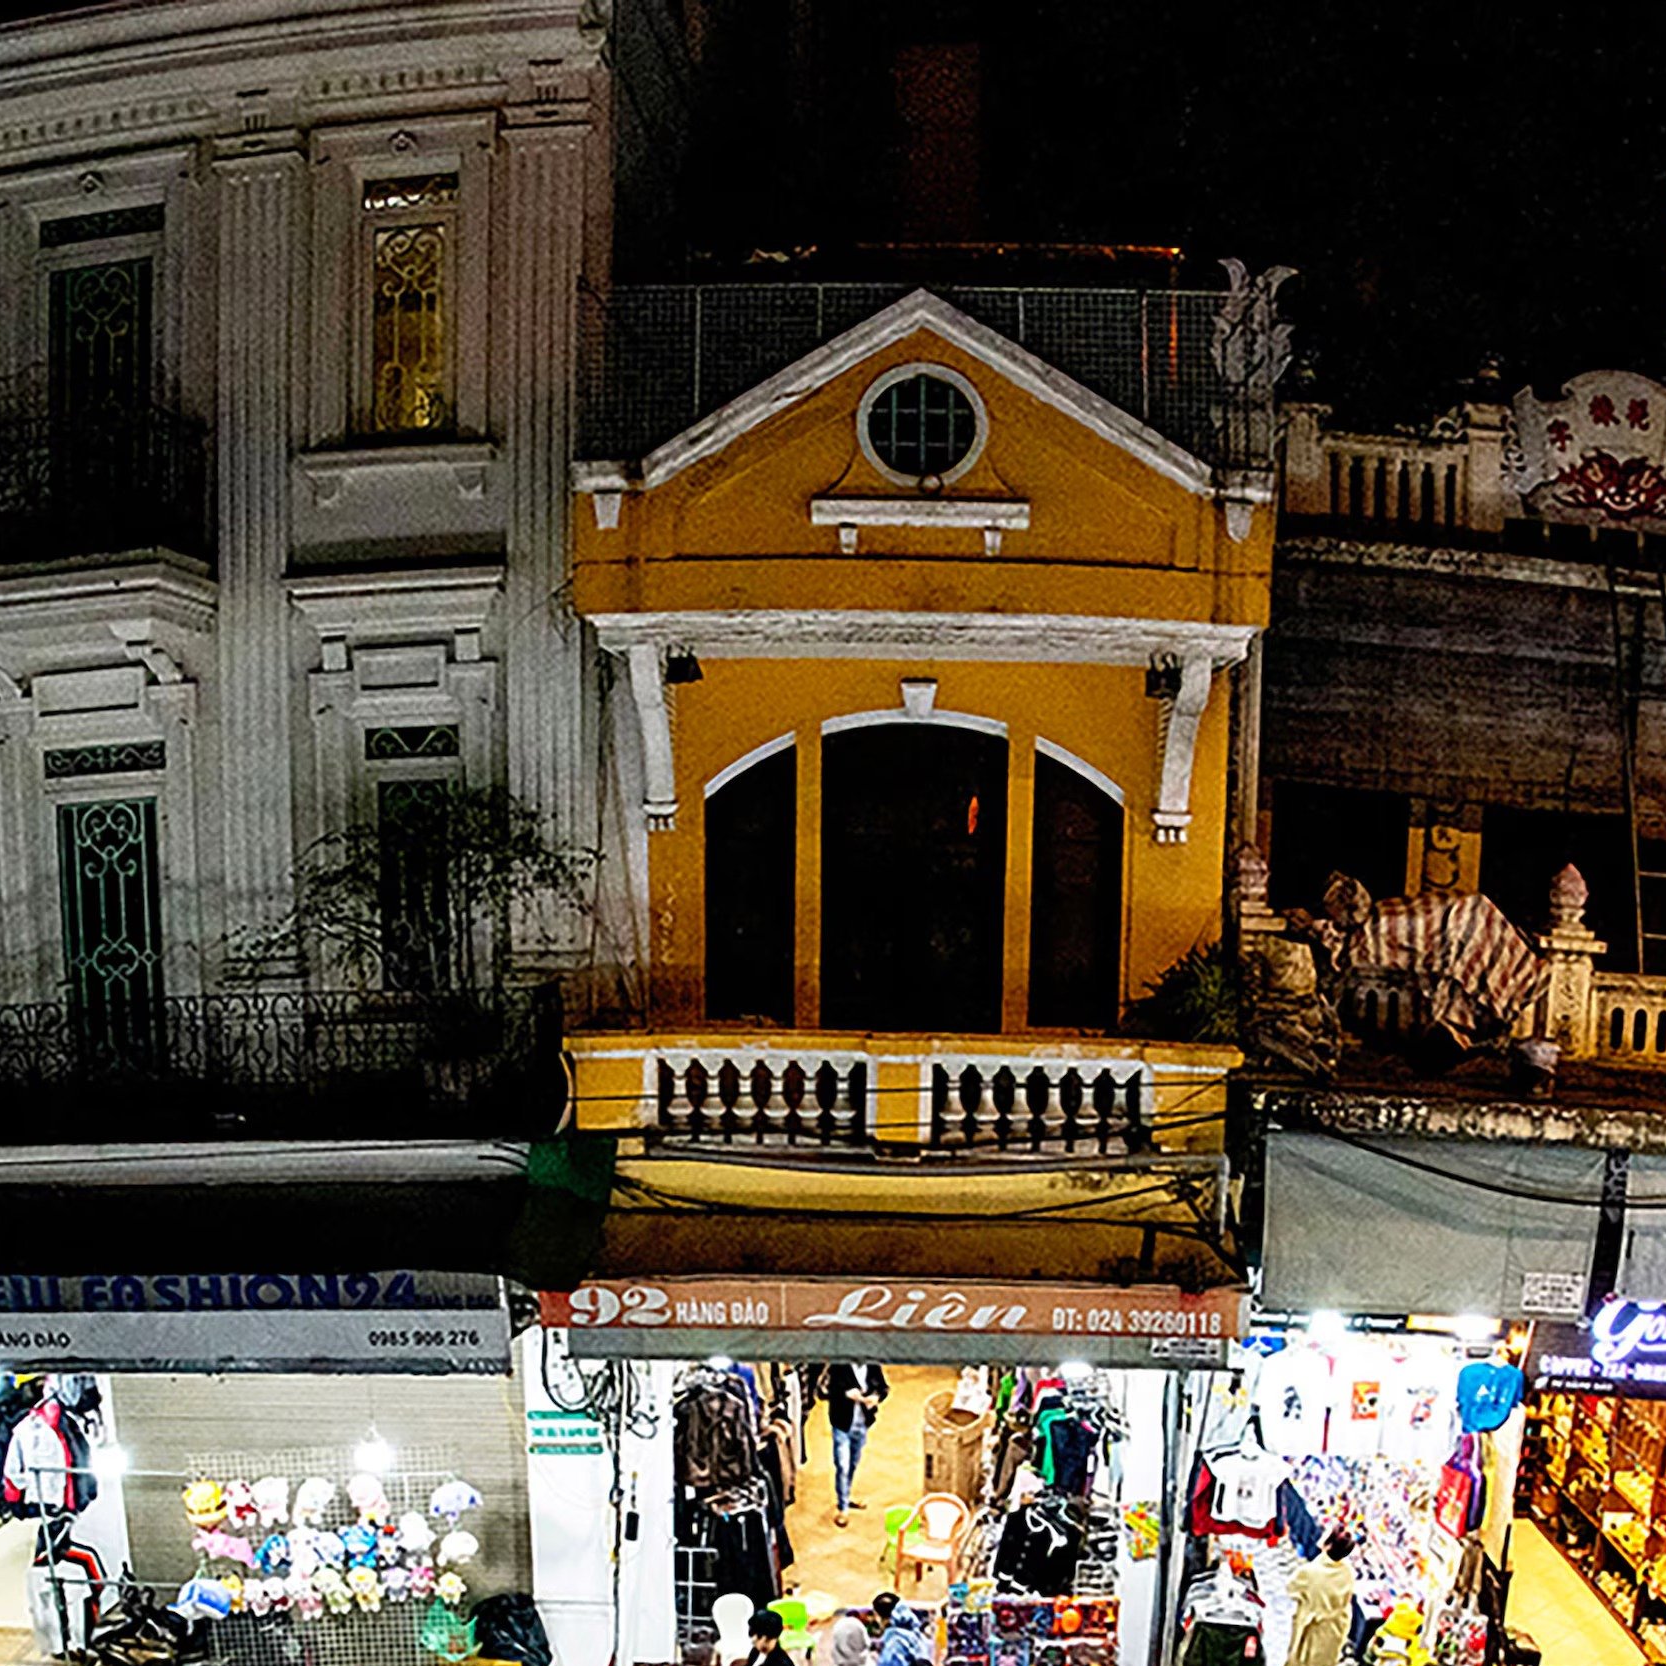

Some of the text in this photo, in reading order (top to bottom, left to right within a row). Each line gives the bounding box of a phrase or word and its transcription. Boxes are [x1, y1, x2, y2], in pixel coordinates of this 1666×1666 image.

[568, 1286, 673, 1327] 92
[675, 1299, 727, 1326] HÀNG
[802, 1285, 1033, 1329] Liên
[1087, 1310, 1124, 1333] 024
